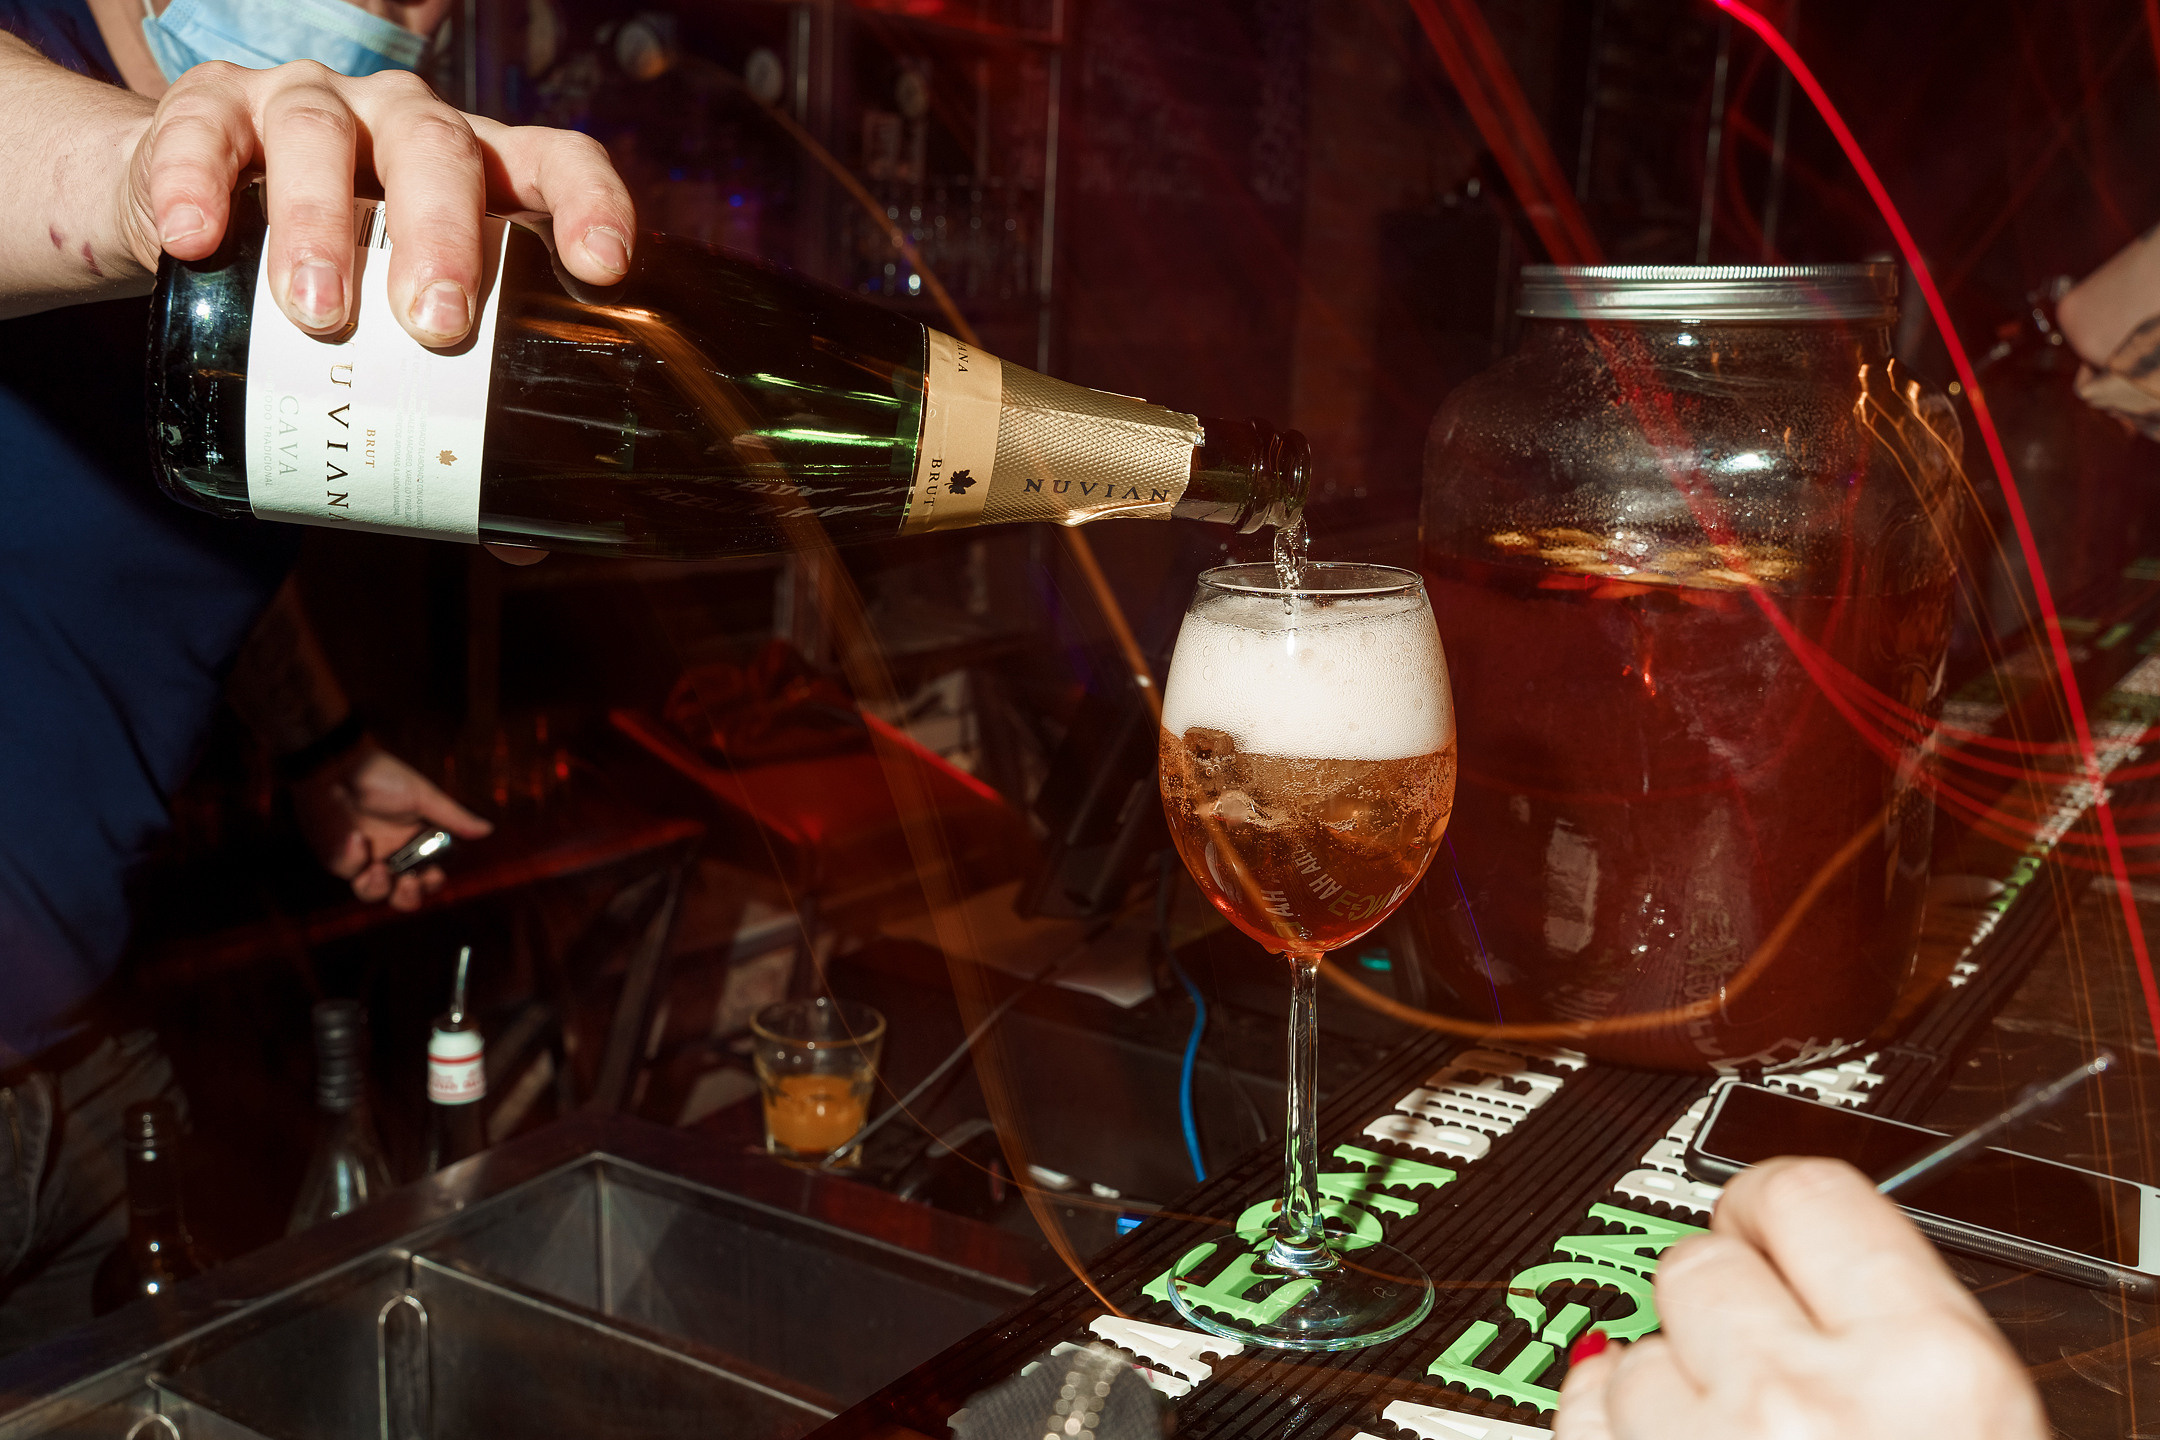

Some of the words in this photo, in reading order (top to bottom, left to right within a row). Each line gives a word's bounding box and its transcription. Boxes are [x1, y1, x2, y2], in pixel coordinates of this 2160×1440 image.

[263, 424, 273, 487] TRADICIONAL
[278, 394, 299, 476] CAVA
[365, 428, 376, 469] BRUT
[922, 457, 943, 508] BRUT
